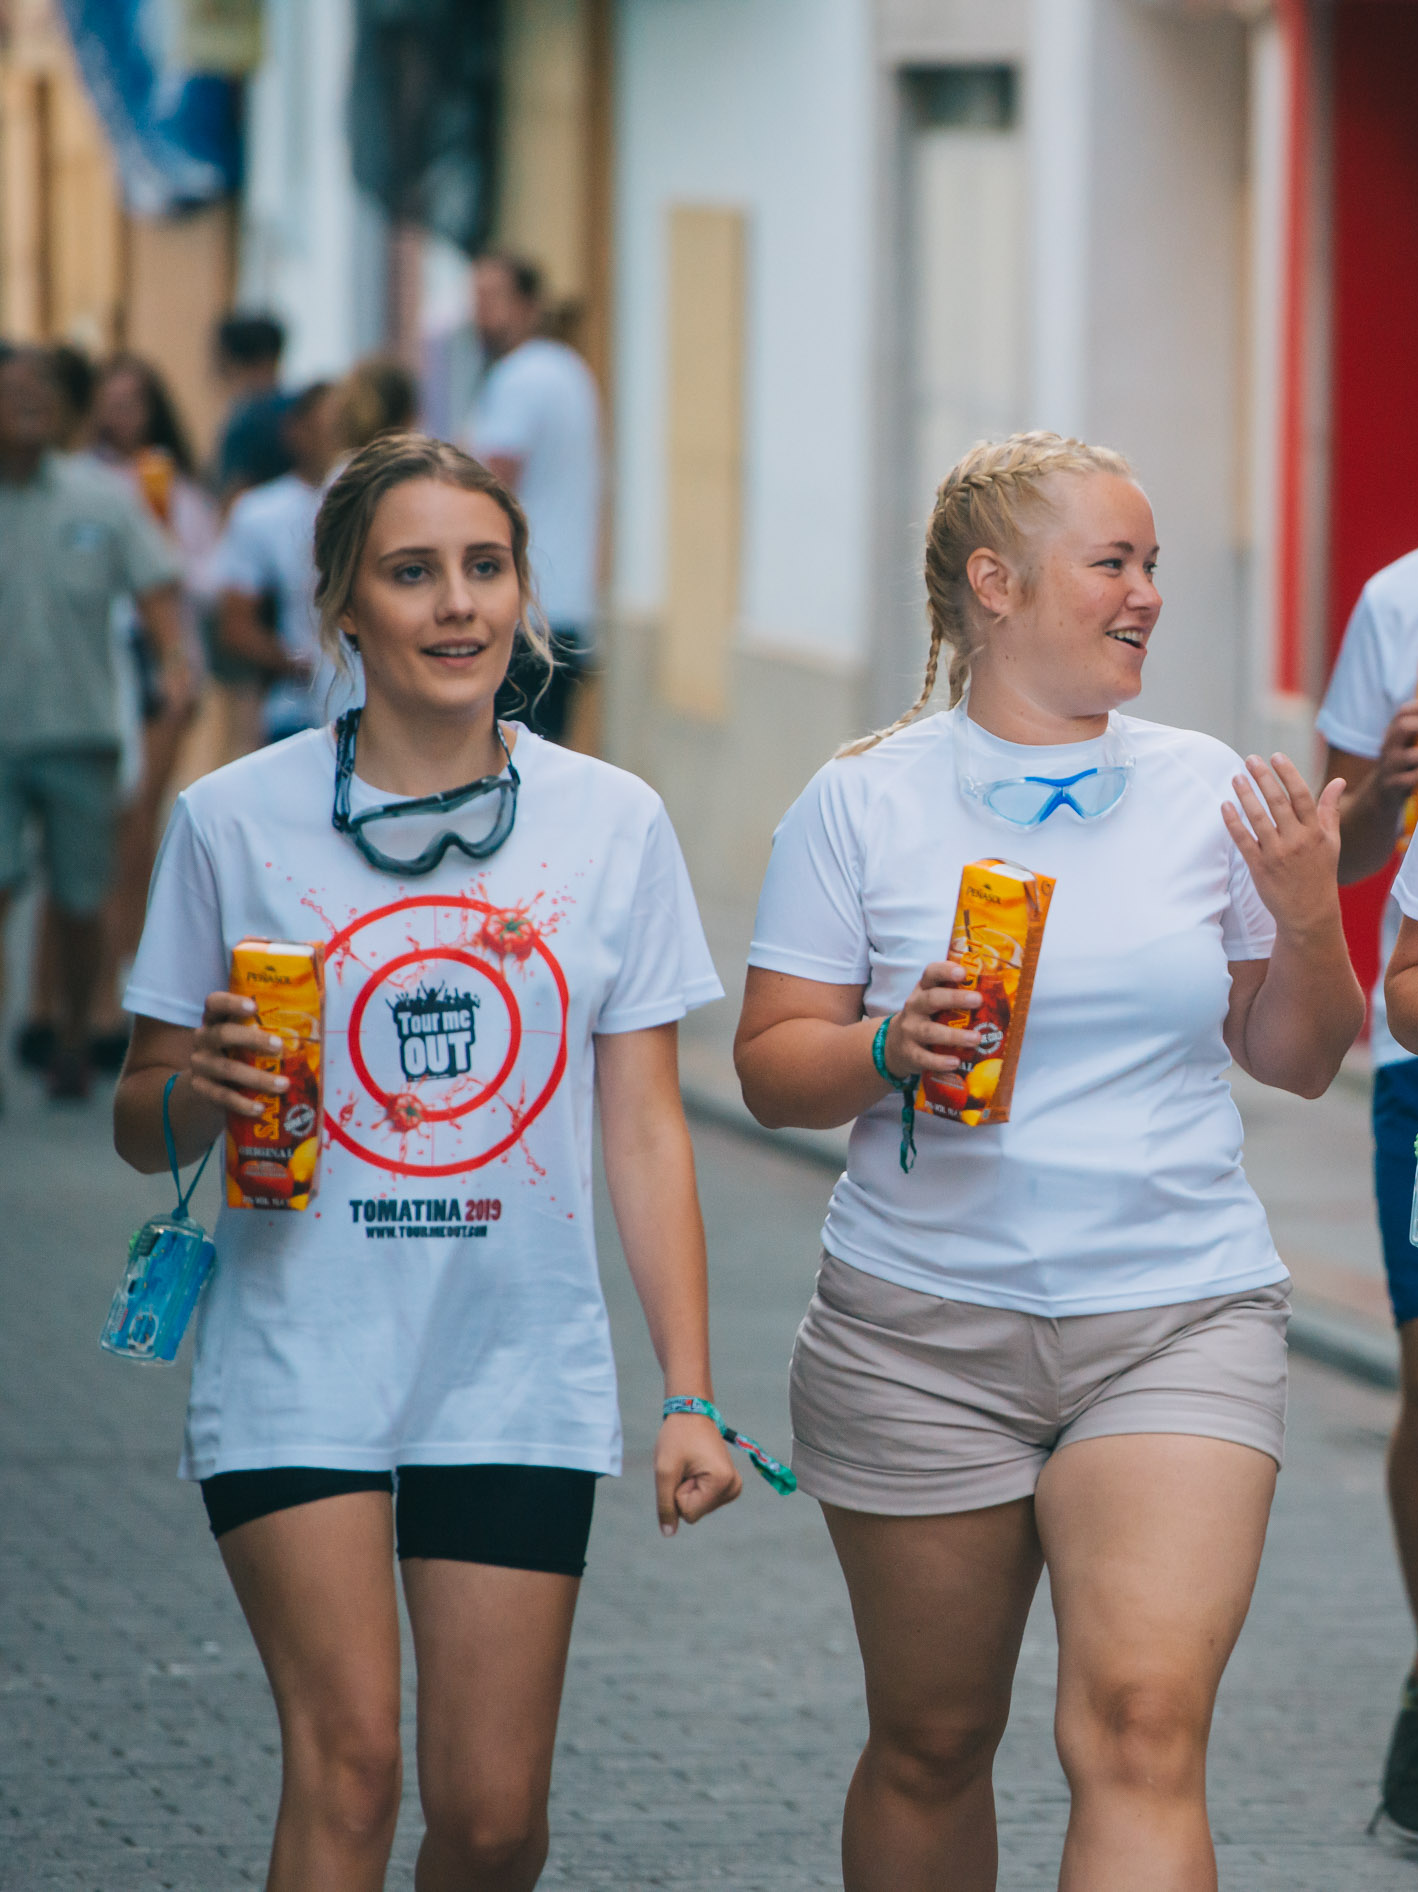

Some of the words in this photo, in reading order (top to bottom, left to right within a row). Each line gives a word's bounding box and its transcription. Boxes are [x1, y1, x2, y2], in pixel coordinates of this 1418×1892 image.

[397, 1011, 440, 1035] Tour
[441, 1009, 471, 1031] me
[403, 1031, 471, 1076] OUT
[349, 1199, 461, 1223] TOMATINA
[465, 1198, 502, 1222] 2019
